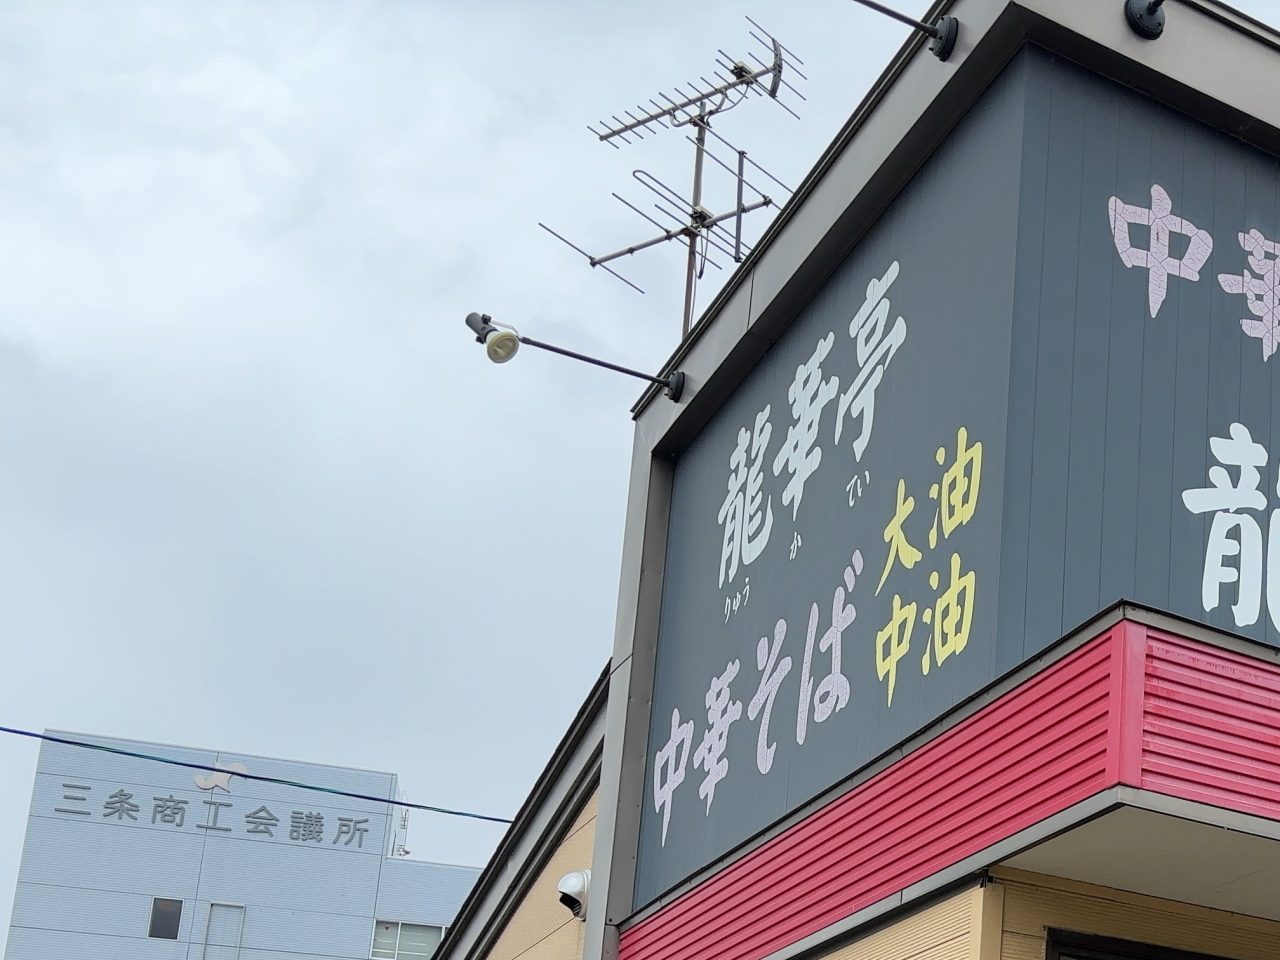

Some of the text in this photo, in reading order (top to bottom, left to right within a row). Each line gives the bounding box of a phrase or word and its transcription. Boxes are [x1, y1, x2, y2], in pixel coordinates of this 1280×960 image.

[718, 260, 907, 590] 龍華亭
[875, 427, 983, 597] 大油
[653, 549, 864, 848] 中華そば
[875, 552, 976, 708] 中油
[54, 782, 369, 849] 三条商工会議所
